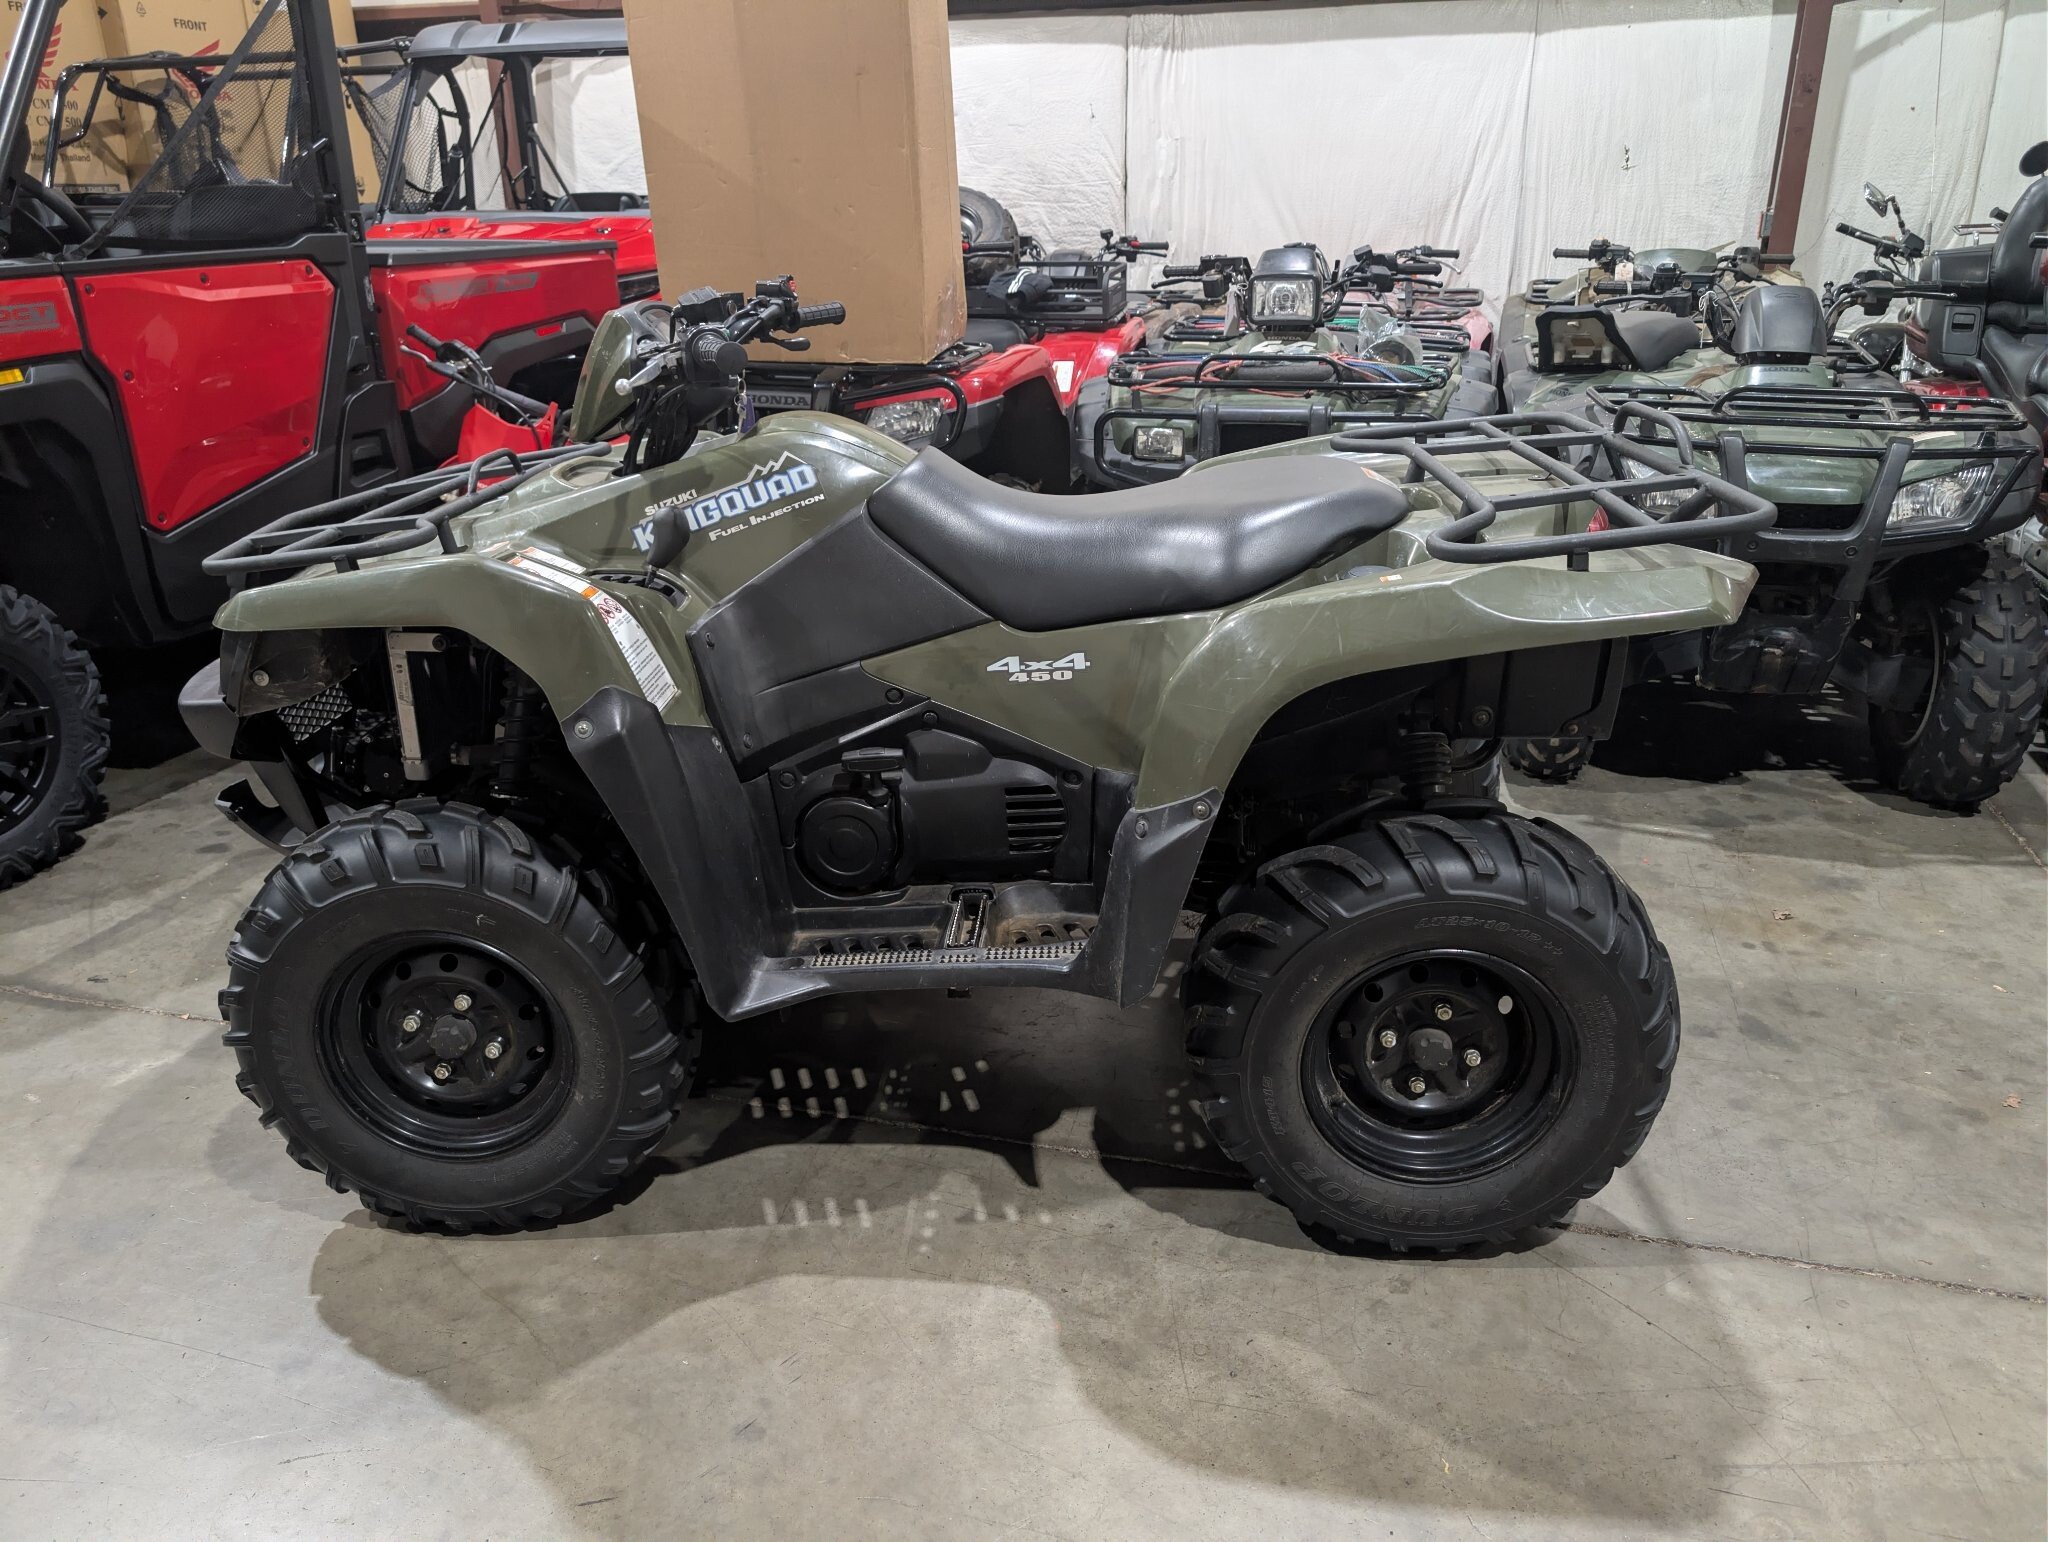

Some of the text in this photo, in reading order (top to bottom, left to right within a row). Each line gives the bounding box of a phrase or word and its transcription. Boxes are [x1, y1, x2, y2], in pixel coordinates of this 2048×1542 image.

[173, 18, 207, 31] FRONT
[631, 463, 818, 553] KGQUAD
[644, 488, 698, 516] SUZUKI
[708, 493, 825, 542] FUEL INJECTION
[986, 652, 1090, 673] 4x4
[1008, 670, 1073, 682] 450
[1289, 1161, 1479, 1228] DUNLOP
